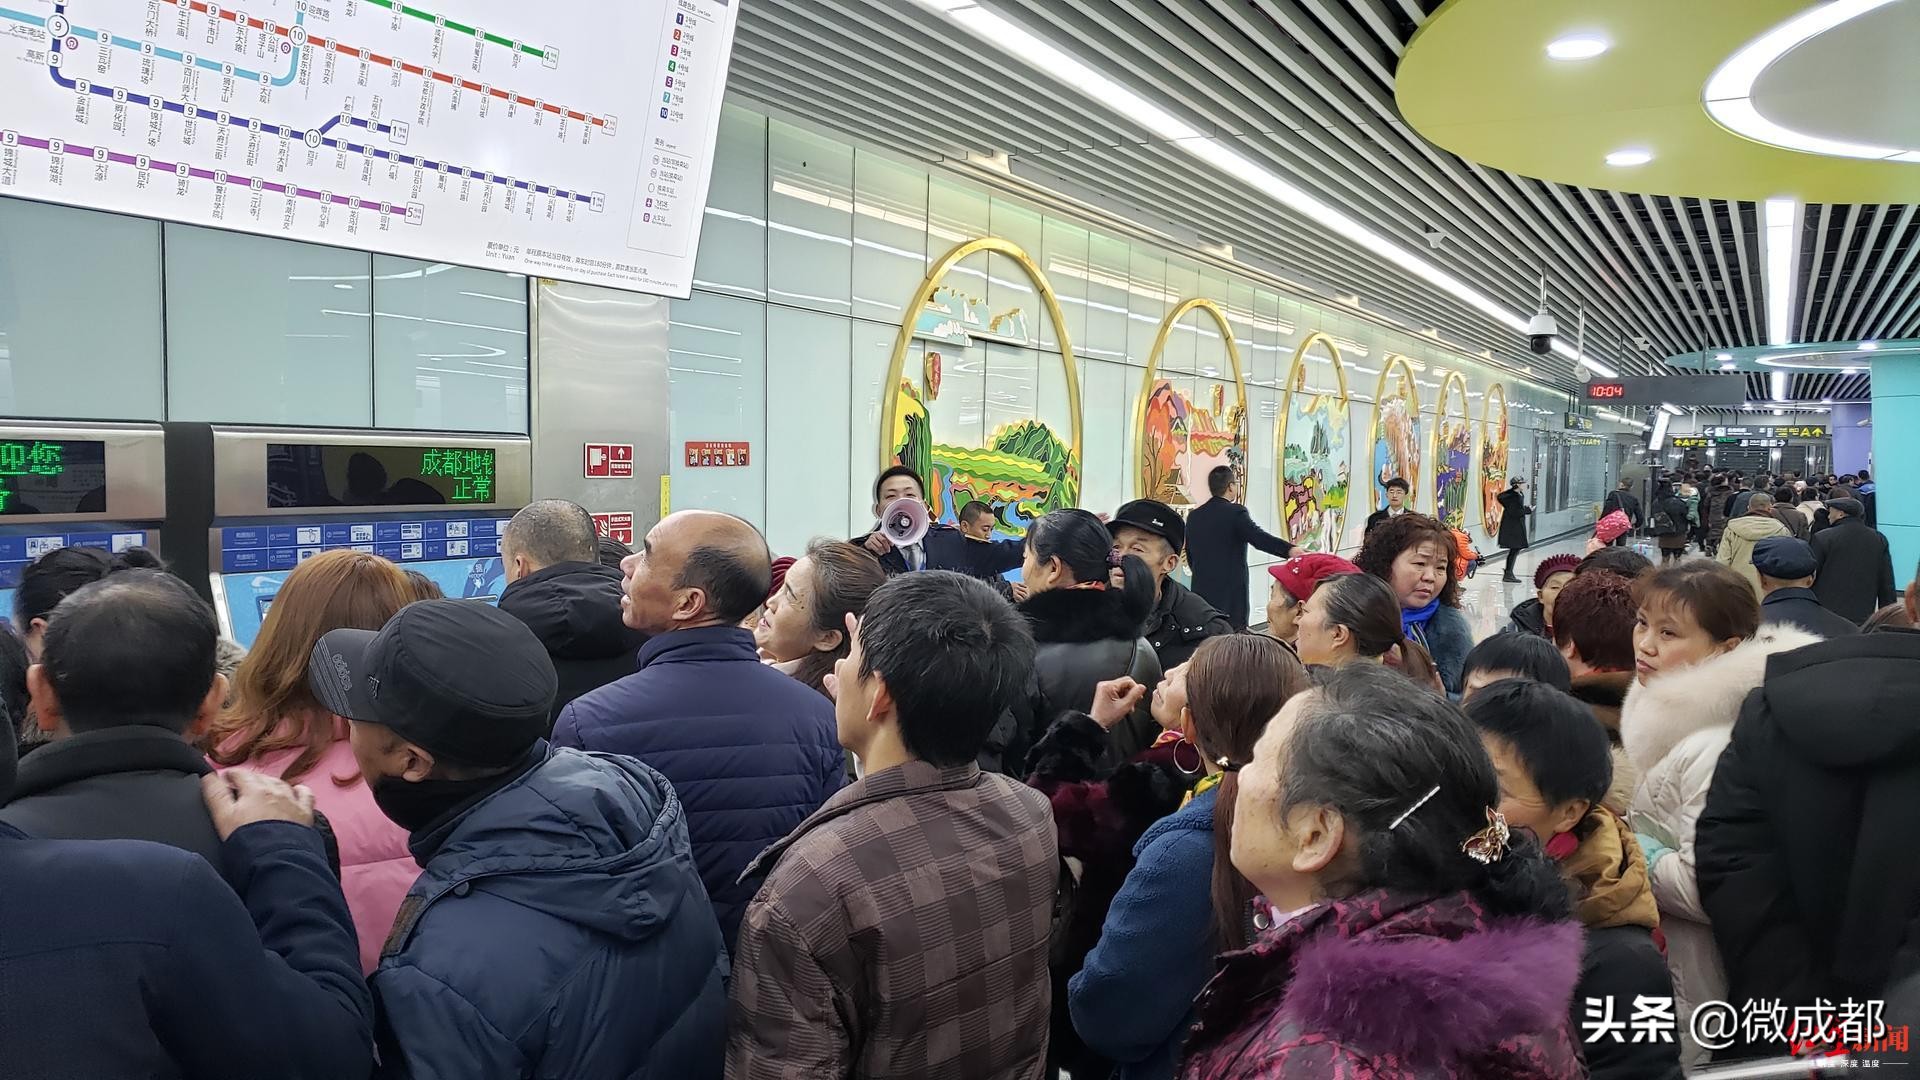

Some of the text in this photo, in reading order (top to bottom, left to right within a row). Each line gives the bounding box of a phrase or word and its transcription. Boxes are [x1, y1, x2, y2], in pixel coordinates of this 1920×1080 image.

[297, 0, 307, 11] 10
[392, 2, 402, 12] 10
[210, 6, 216, 15] 9
[239, 15, 245, 24] 9
[436, 16, 444, 26] 10
[55, 21, 61, 31] 9
[264, 22, 275, 32] 10
[102, 33, 108, 43] 9
[293, 30, 303, 41] 10
[476, 29, 484, 39] 10
[145, 44, 151, 54] 9
[326, 39, 335, 50] 10
[513, 41, 521, 51] 10
[52, 55, 58, 64] 9
[186, 55, 192, 64] 9
[360, 50, 370, 60] 10
[544, 51, 550, 61] 4
[393, 59, 402, 69] 10
[225, 65, 231, 74] 9
[424, 68, 432, 77] 10
[263, 75, 268, 84] 9
[453, 76, 462, 86] 10
[80, 82, 86, 91] 9
[482, 84, 489, 93] 10
[118, 90, 124, 100] 9
[509, 93, 517, 102] 10
[153, 98, 159, 108] 9
[535, 100, 543, 110] 10
[188, 107, 194, 116] 9
[561, 107, 568, 116] 10
[220, 114, 226, 123] 9
[341, 115, 350, 124] 10
[585, 114, 592, 124] 10
[252, 121, 258, 130] 9
[369, 121, 377, 130] 10
[604, 120, 609, 129] 2
[280, 128, 290, 138] 10
[392, 126, 396, 137] 1
[7, 134, 14, 143] 9
[308, 134, 318, 143] 10
[53, 142, 59, 151] 9
[338, 140, 346, 149] 10
[98, 150, 104, 159] 9
[364, 146, 373, 156] 10
[390, 152, 398, 161] 10
[140, 158, 146, 167] 9
[415, 158, 423, 166] 10
[180, 165, 186, 174] 9
[439, 163, 447, 172] 10
[216, 172, 225, 182] 10
[463, 168, 470, 177] 10
[252, 179, 261, 188] 10
[286, 186, 296, 195] 10
[322, 192, 331, 202] 10
[592, 197, 596, 206] 1
[350, 198, 359, 207] 10
[381, 204, 390, 213] 10
[407, 207, 414, 218] 5
[1593, 386, 1623, 397] 10:04
[1800, 427, 1811, 437] A
[452, 476, 491, 501] 正常
